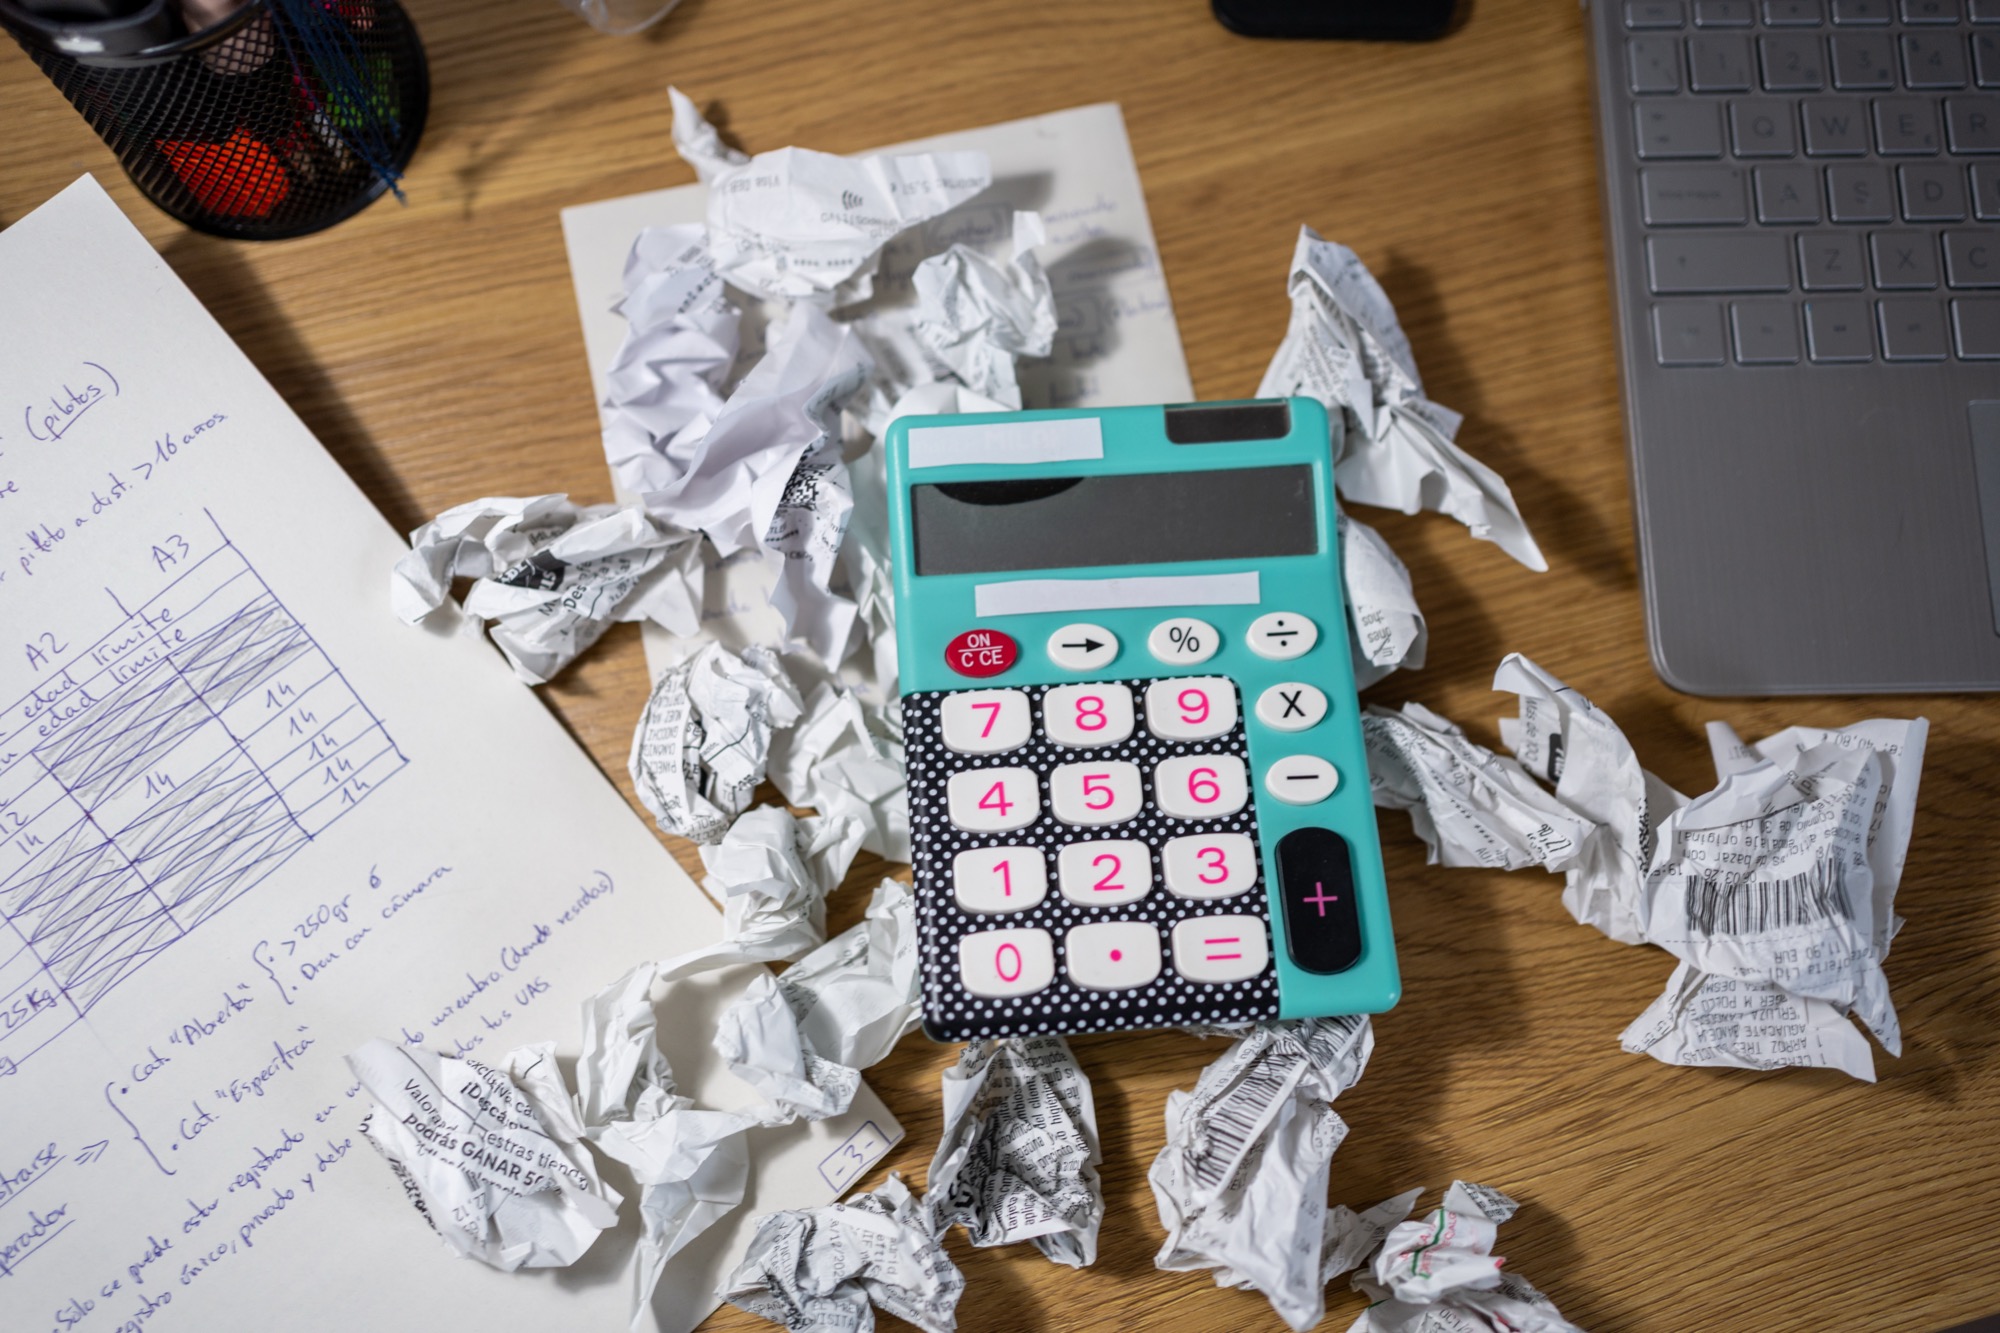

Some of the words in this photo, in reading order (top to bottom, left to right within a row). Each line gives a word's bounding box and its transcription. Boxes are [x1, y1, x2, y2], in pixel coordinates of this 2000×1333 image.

[1751, 115, 1776, 138] Q
[1820, 115, 1851, 137] W
[1898, 113, 1915, 136] E
[1969, 113, 1988, 133] R
[1923, 179, 1944, 202] D
[1824, 248, 1842, 272] Z
[1968, 247, 1988, 268] C
[155, 433, 178, 463] 16
[151, 534, 190, 573] A3
[25, 631, 69, 671] A2
[960, 652, 974, 667] C
[979, 649, 1004, 666] CE
[967, 632, 992, 649] ON
[1168, 626, 1201, 654] %
[23, 673, 79, 720] edad
[37, 684, 101, 738] edad
[1073, 695, 1109, 732] 8
[1176, 688, 1212, 725] 9
[970, 702, 1003, 738] 7
[977, 780, 1014, 817] 4
[1082, 773, 1116, 811] 5
[1186, 767, 1223, 804] 6
[1091, 853, 1126, 892] 2
[1195, 846, 1231, 885] 3
[1712, 850, 1752, 867] bazar
[991, 859, 1013, 897] 1
[993, 942, 1023, 983] 0
[1772, 947, 1798, 964] EUR
[1768, 966, 1801, 983] Lidl
[1742, 1022, 1807, 1038] AGUACATE
[1750, 1005, 1801, 1021] ERLUZA
[1769, 1036, 1808, 1055] ARROZ
[401, 1111, 460, 1151] podrás
[460, 1140, 523, 1182] GANAR
